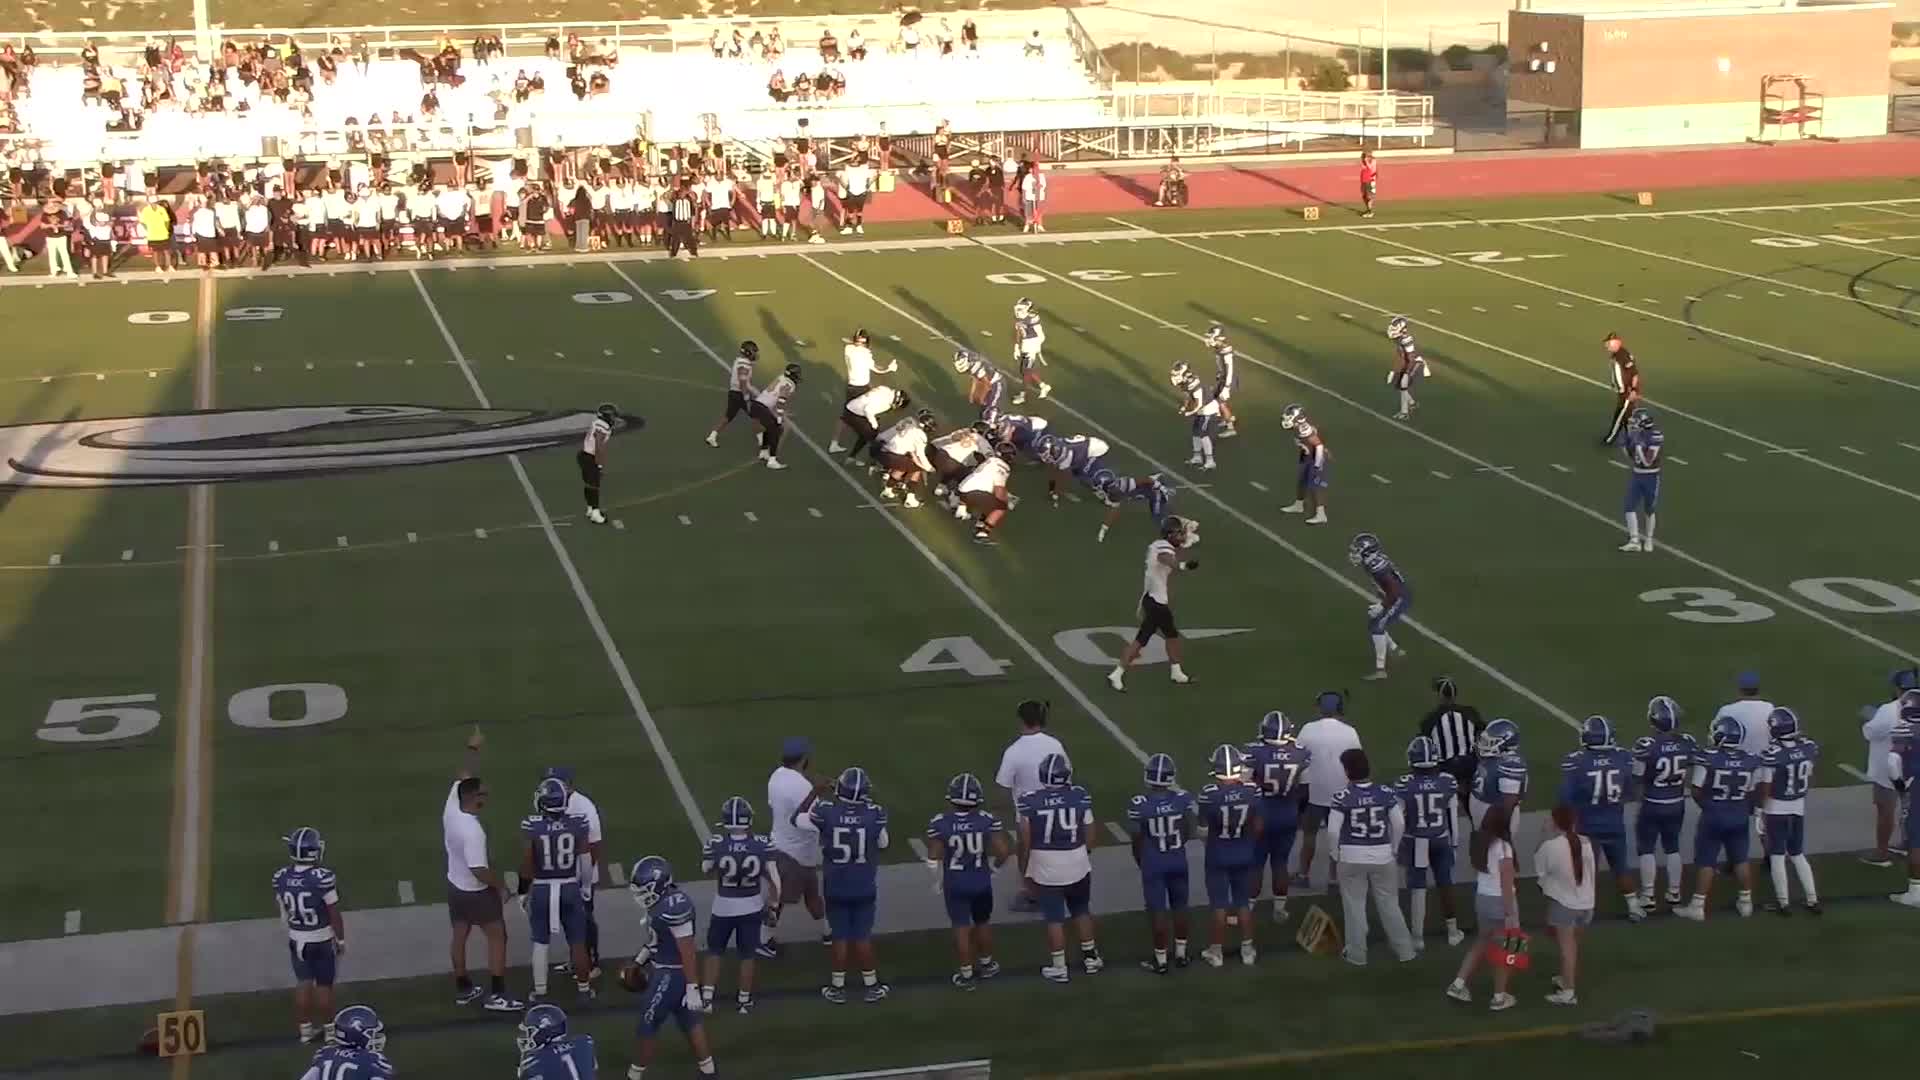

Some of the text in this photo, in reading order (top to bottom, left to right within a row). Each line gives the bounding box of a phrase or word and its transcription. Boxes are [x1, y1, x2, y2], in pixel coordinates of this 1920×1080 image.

[1263, 763, 1299, 796] 57
[1587, 769, 1621, 805] 76
[1653, 755, 1688, 787] 25
[1712, 769, 1752, 800] 53
[1784, 760, 1813, 796] 19
[1037, 807, 1078, 844] 74
[1219, 804, 1249, 839] 17
[1350, 806, 1386, 838] 55
[1414, 793, 1444, 828] 15
[832, 826, 866, 864] 51
[1148, 813, 1183, 852] 45
[540, 832, 575, 870] 18
[948, 831, 984, 871] 24
[720, 855, 760, 887] 22
[284, 891, 319, 926] 26
[1505, 953, 1516, 966] G
[164, 1015, 201, 1054] 50
